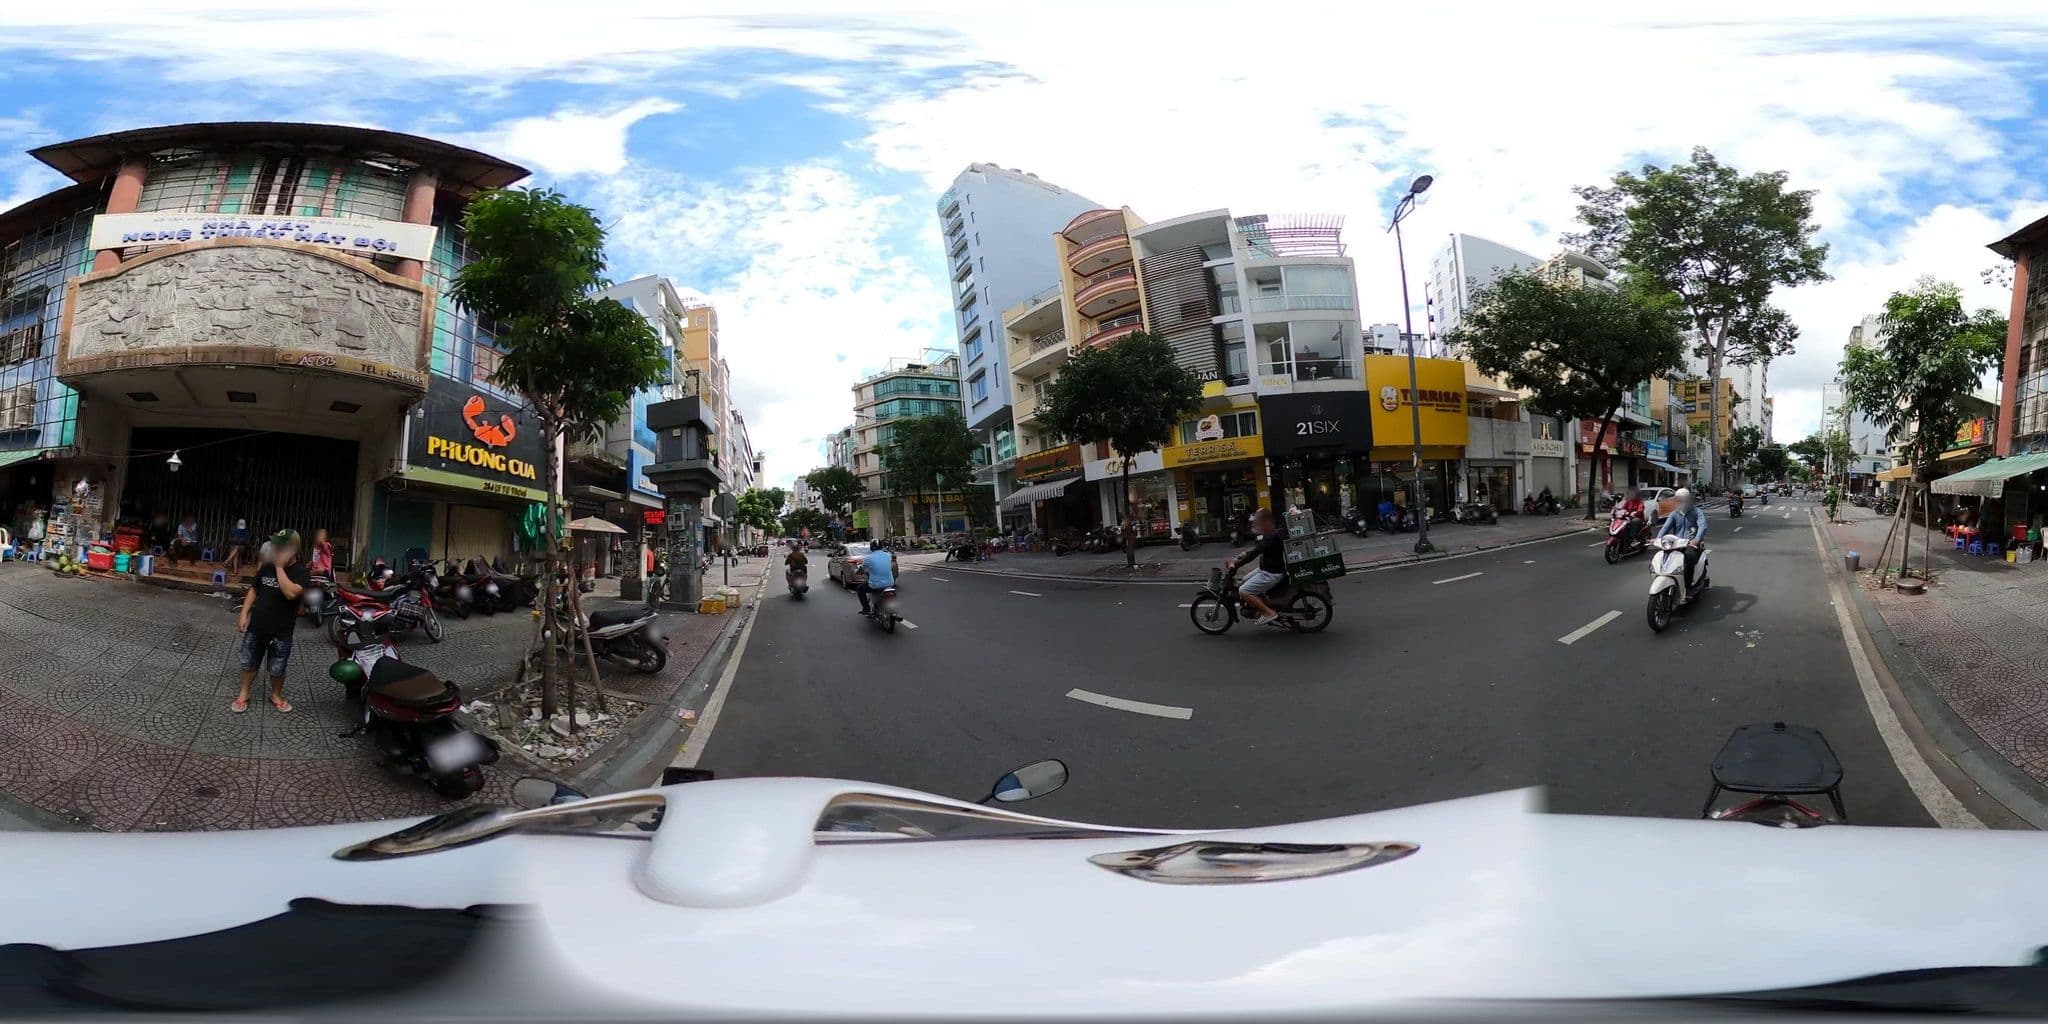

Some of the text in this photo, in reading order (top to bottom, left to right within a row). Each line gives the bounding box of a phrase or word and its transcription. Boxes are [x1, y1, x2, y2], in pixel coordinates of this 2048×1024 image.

[122, 229, 193, 243] NGHỆ
[294, 232, 347, 245] HÁT
[353, 236, 397, 251] BỘI
[360, 364, 378, 375] TEL
[1400, 388, 1462, 403] TRRISA
[1296, 420, 1340, 435] 21SIX
[1185, 442, 1237, 457] TERRISA
[427, 436, 536, 480] PHƯƠNG CUA
[908, 495, 936, 505] NAM
